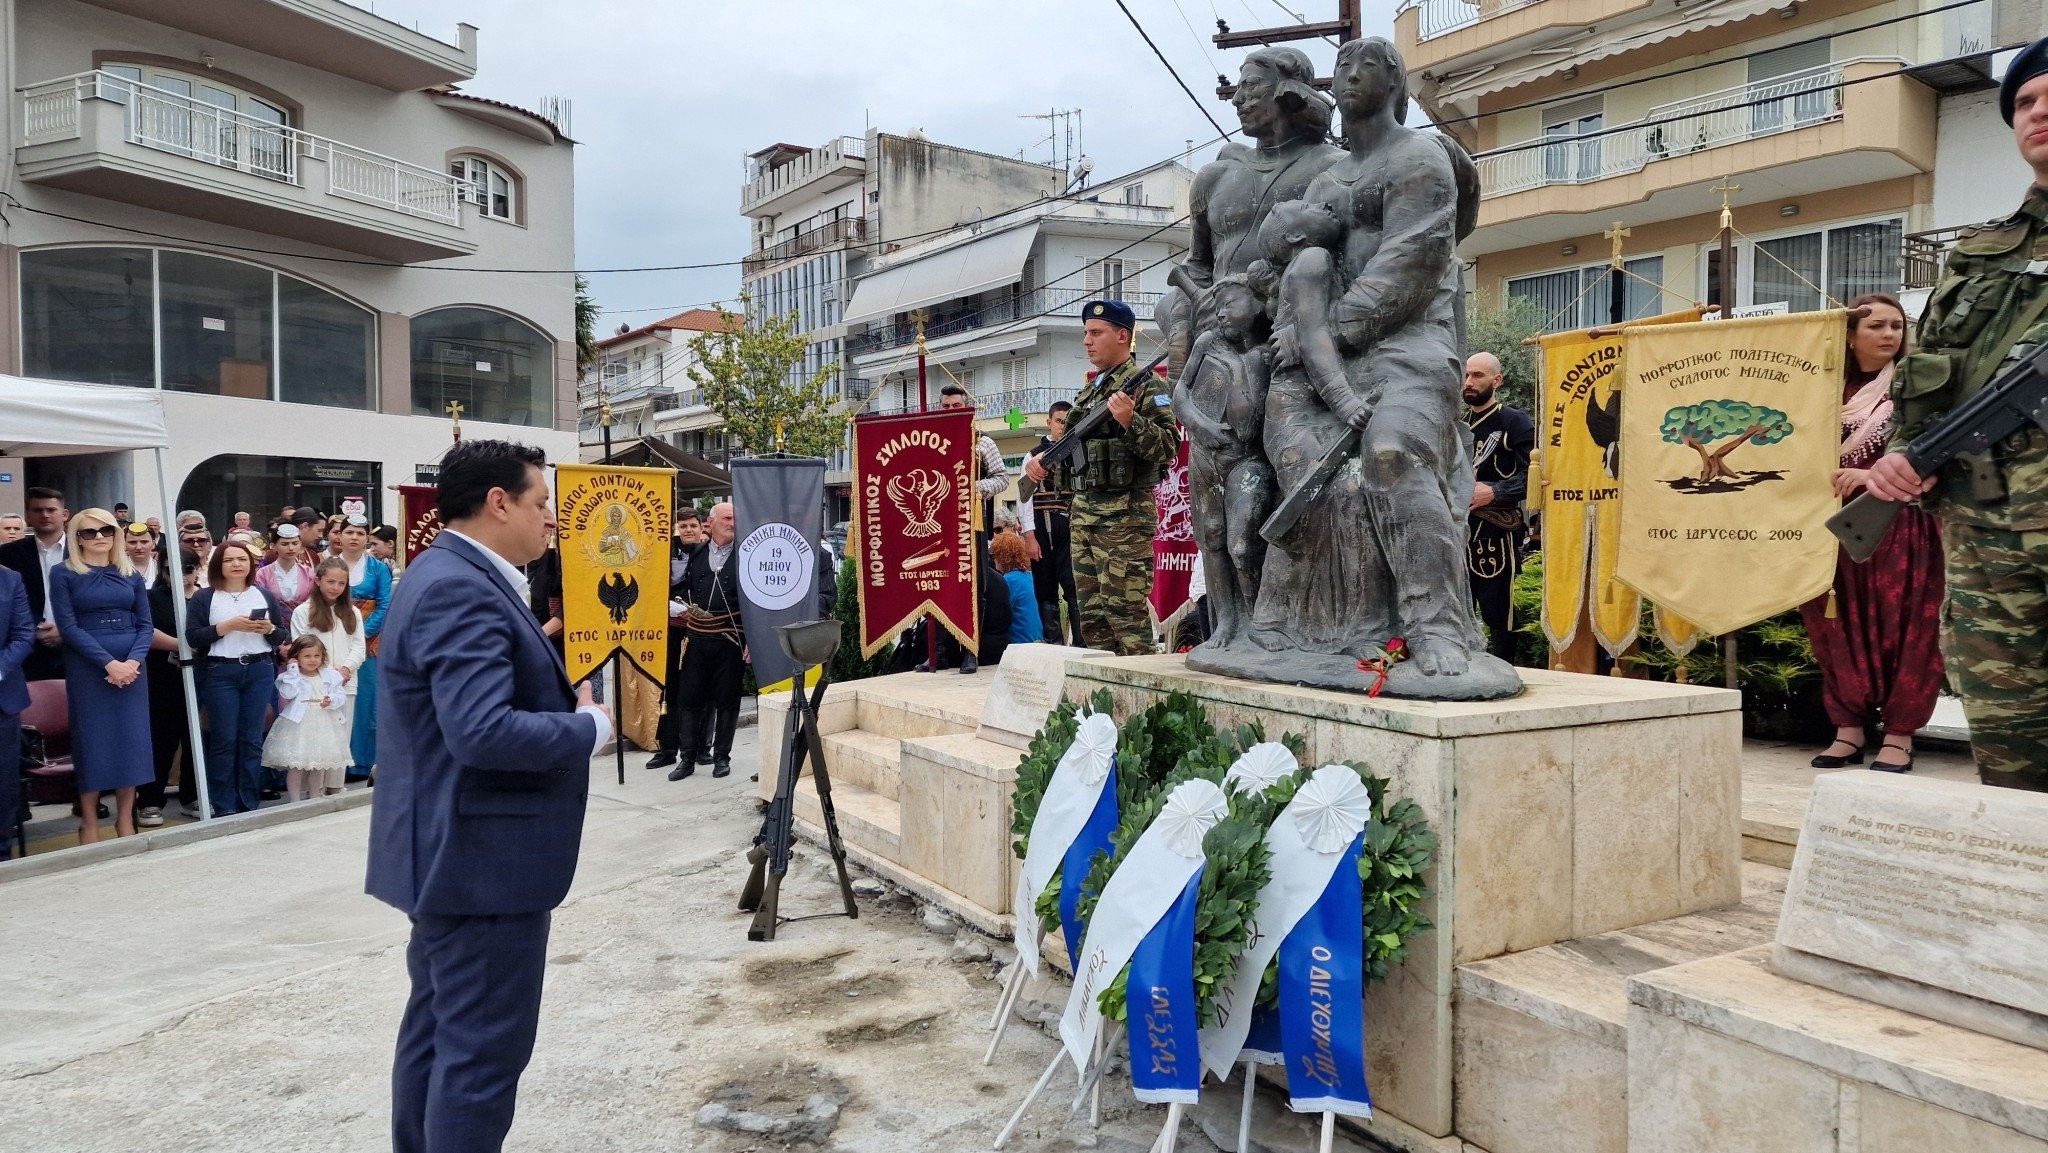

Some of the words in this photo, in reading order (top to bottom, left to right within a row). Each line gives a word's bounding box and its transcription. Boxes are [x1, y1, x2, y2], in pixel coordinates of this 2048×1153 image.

[876, 430, 951, 466] ΣΥΛΛΟΓΟΣ
[1554, 490, 1584, 500] ΕΤΟΣ
[866, 474, 885, 586] ΜΟΡΦΩΤΙΚΟΣ
[953, 460, 972, 582] ΚΩΝΣΤΑΝΤΙΑΣ
[742, 526, 775, 553] ΕΘΝΙΚΗ
[780, 526, 810, 554] ΜΝΗΜΗ
[1769, 530, 1803, 540] 2009
[772, 548, 782, 558] 19
[764, 575, 786, 586] 1919
[900, 571, 918, 580] ΕΤΟΣ
[916, 580, 940, 591] 1983
[578, 652, 592, 664] 19
[640, 651, 654, 662] 69
[1312, 946, 1332, 962] Ο
